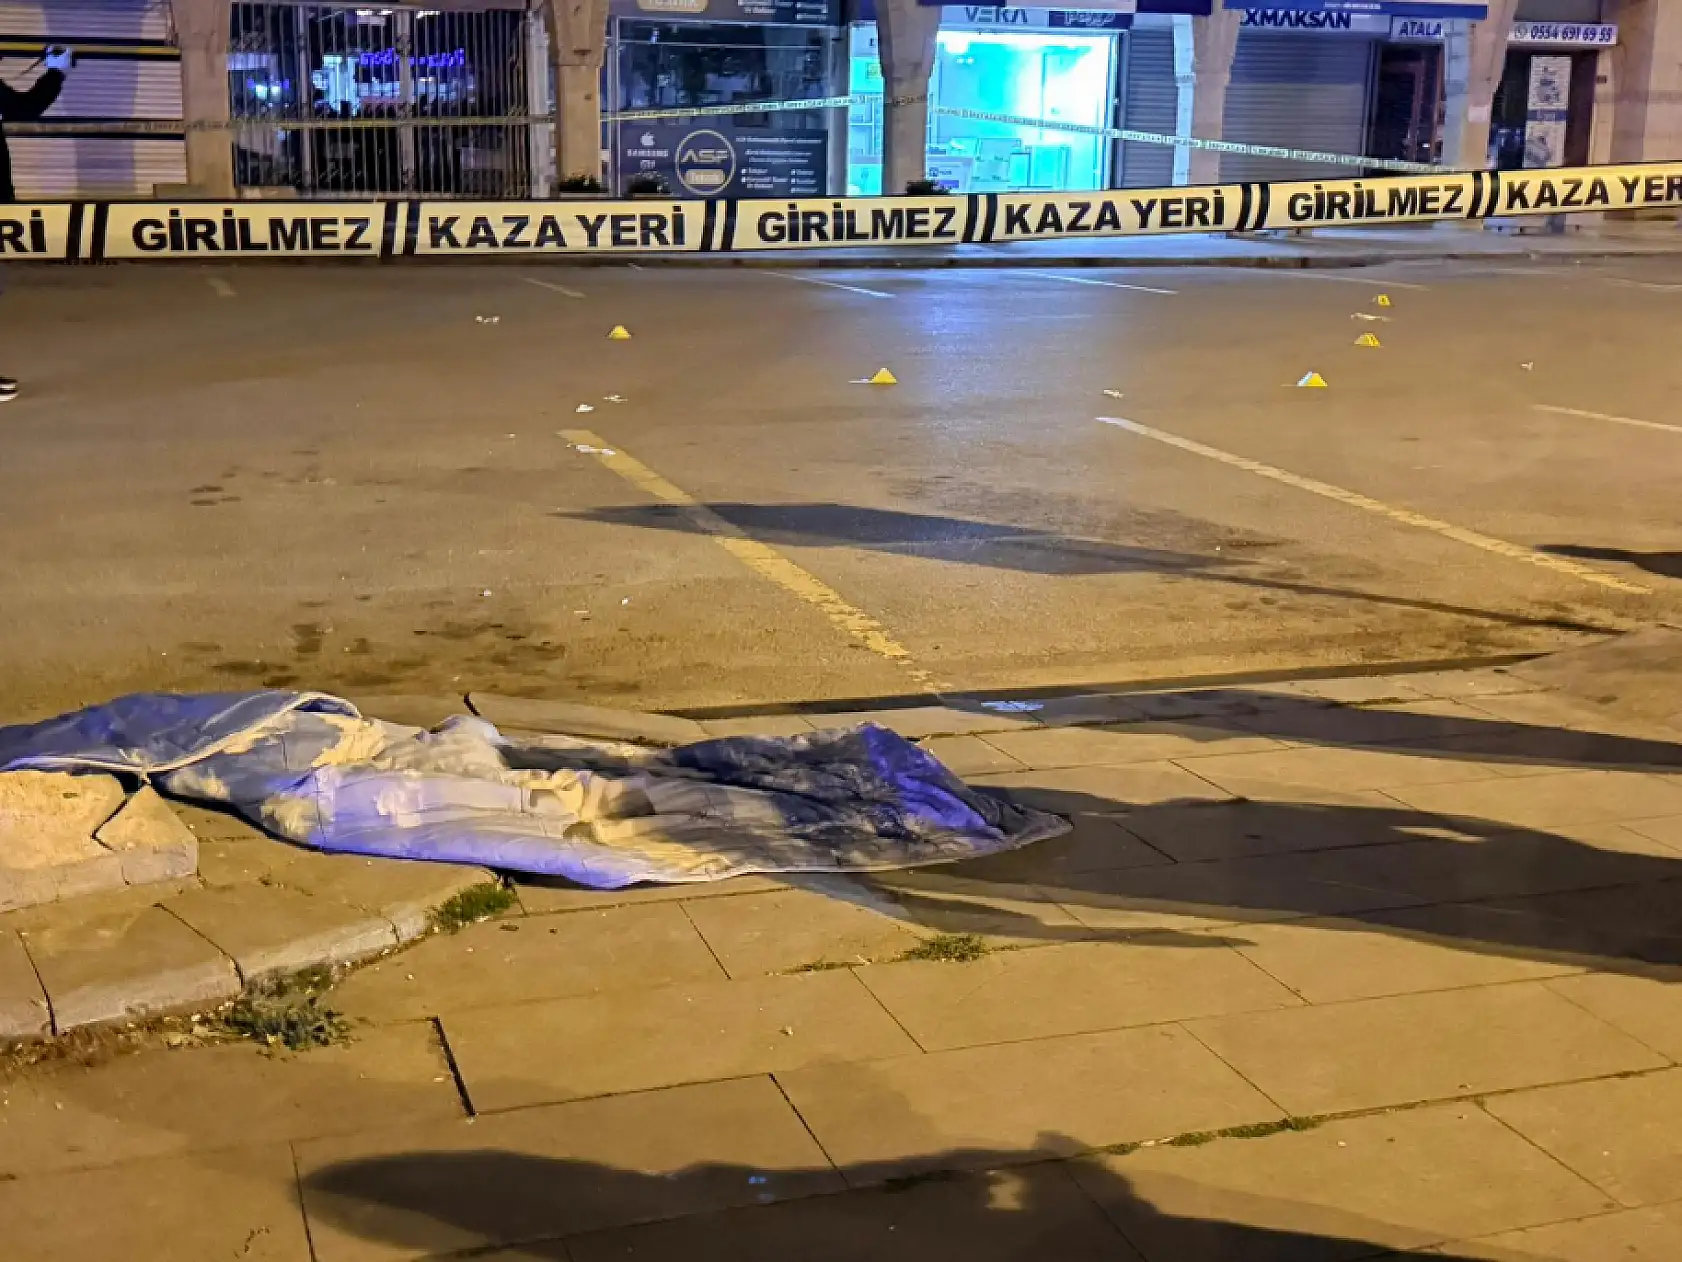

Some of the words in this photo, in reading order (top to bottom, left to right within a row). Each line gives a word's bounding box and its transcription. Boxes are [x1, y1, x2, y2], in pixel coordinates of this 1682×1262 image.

[1240, 7, 1351, 29] XMAKSAN
[132, 208, 373, 252] GİRİLMEZ
[428, 214, 568, 250] KAZA
[574, 206, 685, 249] YERİ
[757, 202, 956, 243] GİRİLMEZ
[1004, 199, 1122, 237] KAZA
[1128, 189, 1226, 230] YERİ
[1287, 181, 1465, 223] GİRİLMEZ
[1506, 178, 1611, 210] KAZA
